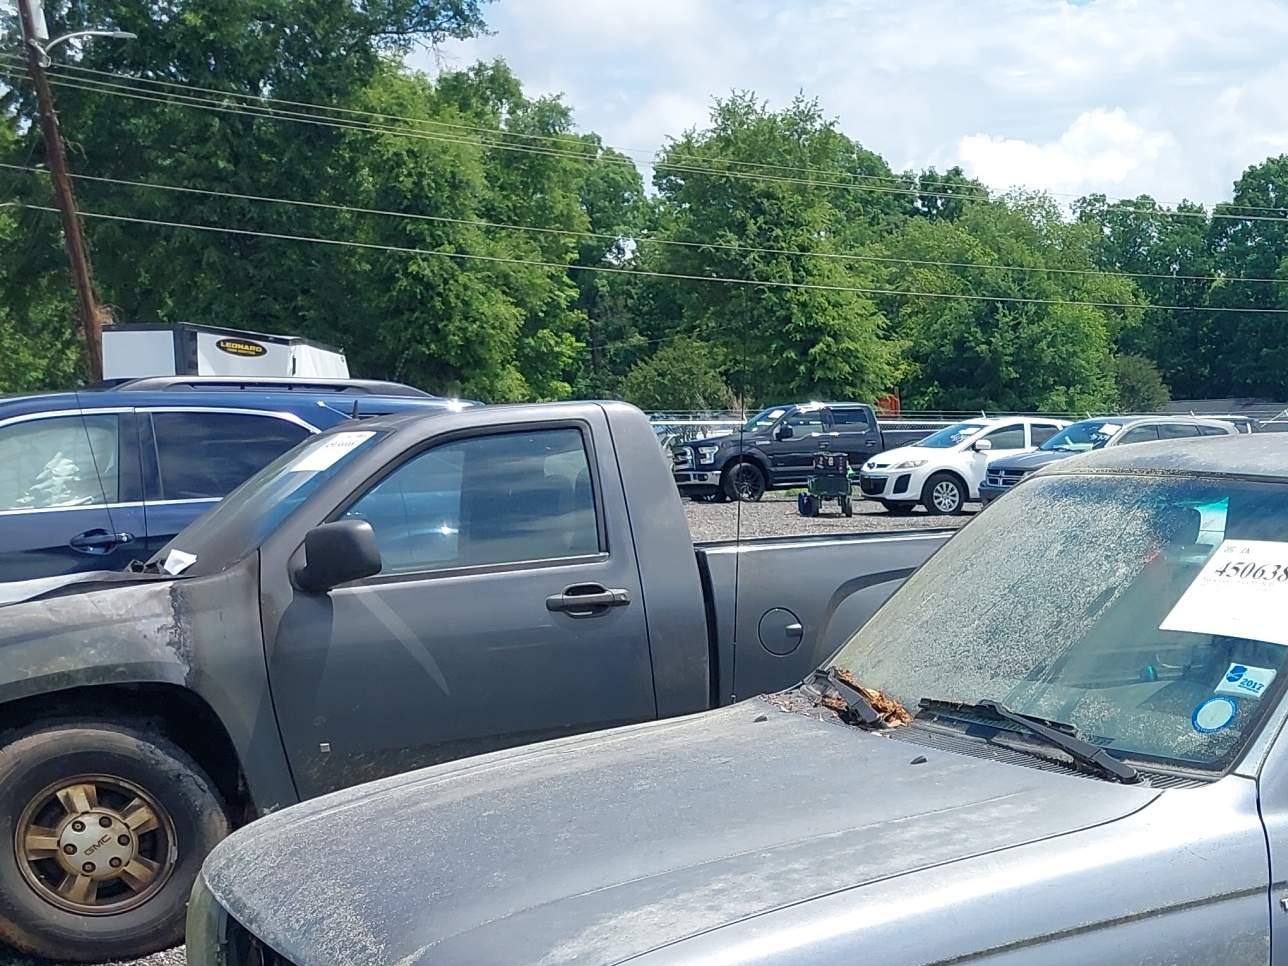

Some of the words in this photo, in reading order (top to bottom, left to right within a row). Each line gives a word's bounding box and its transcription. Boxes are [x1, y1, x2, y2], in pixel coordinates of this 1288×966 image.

[220, 341, 262, 353] LEONARD
[1240, 678, 1264, 690] 2017
[84, 834, 112, 856] GMC
